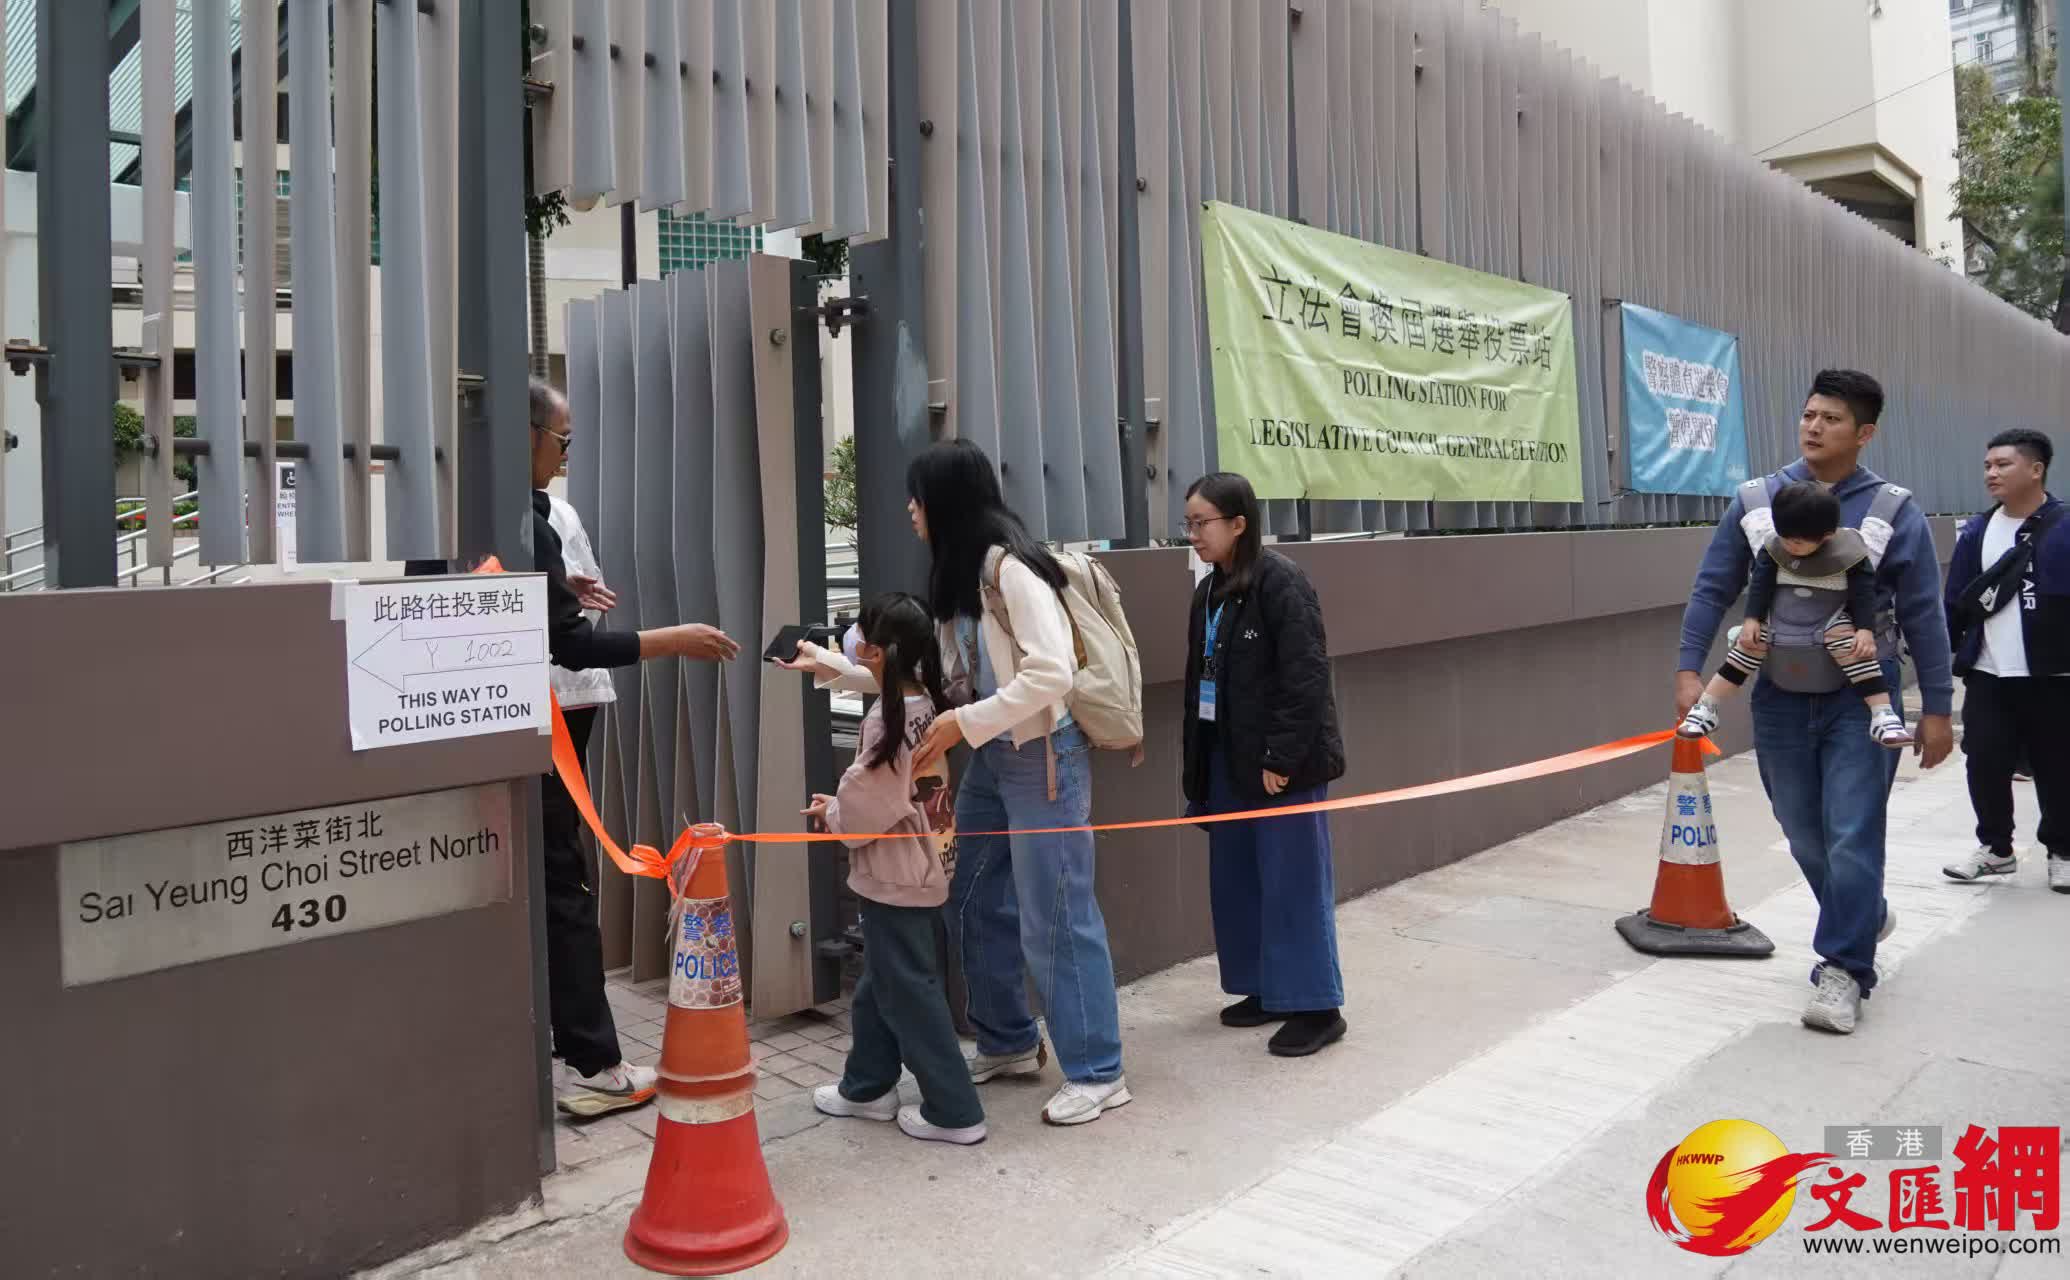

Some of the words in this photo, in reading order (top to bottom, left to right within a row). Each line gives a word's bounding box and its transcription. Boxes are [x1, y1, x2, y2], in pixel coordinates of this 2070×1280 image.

[1343, 370, 1416, 403] POLLING
[1419, 381, 1477, 409] STATION
[1480, 388, 1507, 412] FOR
[1250, 418, 1373, 452] LEGISLATIVE
[1446, 435, 1509, 461] GENERAL
[373, 588, 524, 622] 此路往投票站
[2022, 579, 2036, 610] AIR
[464, 639, 513, 663] 1002
[398, 691, 437, 710] THIS
[442, 687, 482, 704] WAY
[486, 684, 508, 699] TO
[379, 713, 455, 734] POLLING
[460, 702, 531, 724] STATION
[226, 811, 383, 862] 西洋菜街北
[145, 873, 248, 912] Yeung
[261, 856, 328, 892] Choi
[339, 845, 421, 878] Street
[430, 827, 499, 862] North
[271, 894, 347, 932] 430
[674, 951, 738, 979] POLICE
